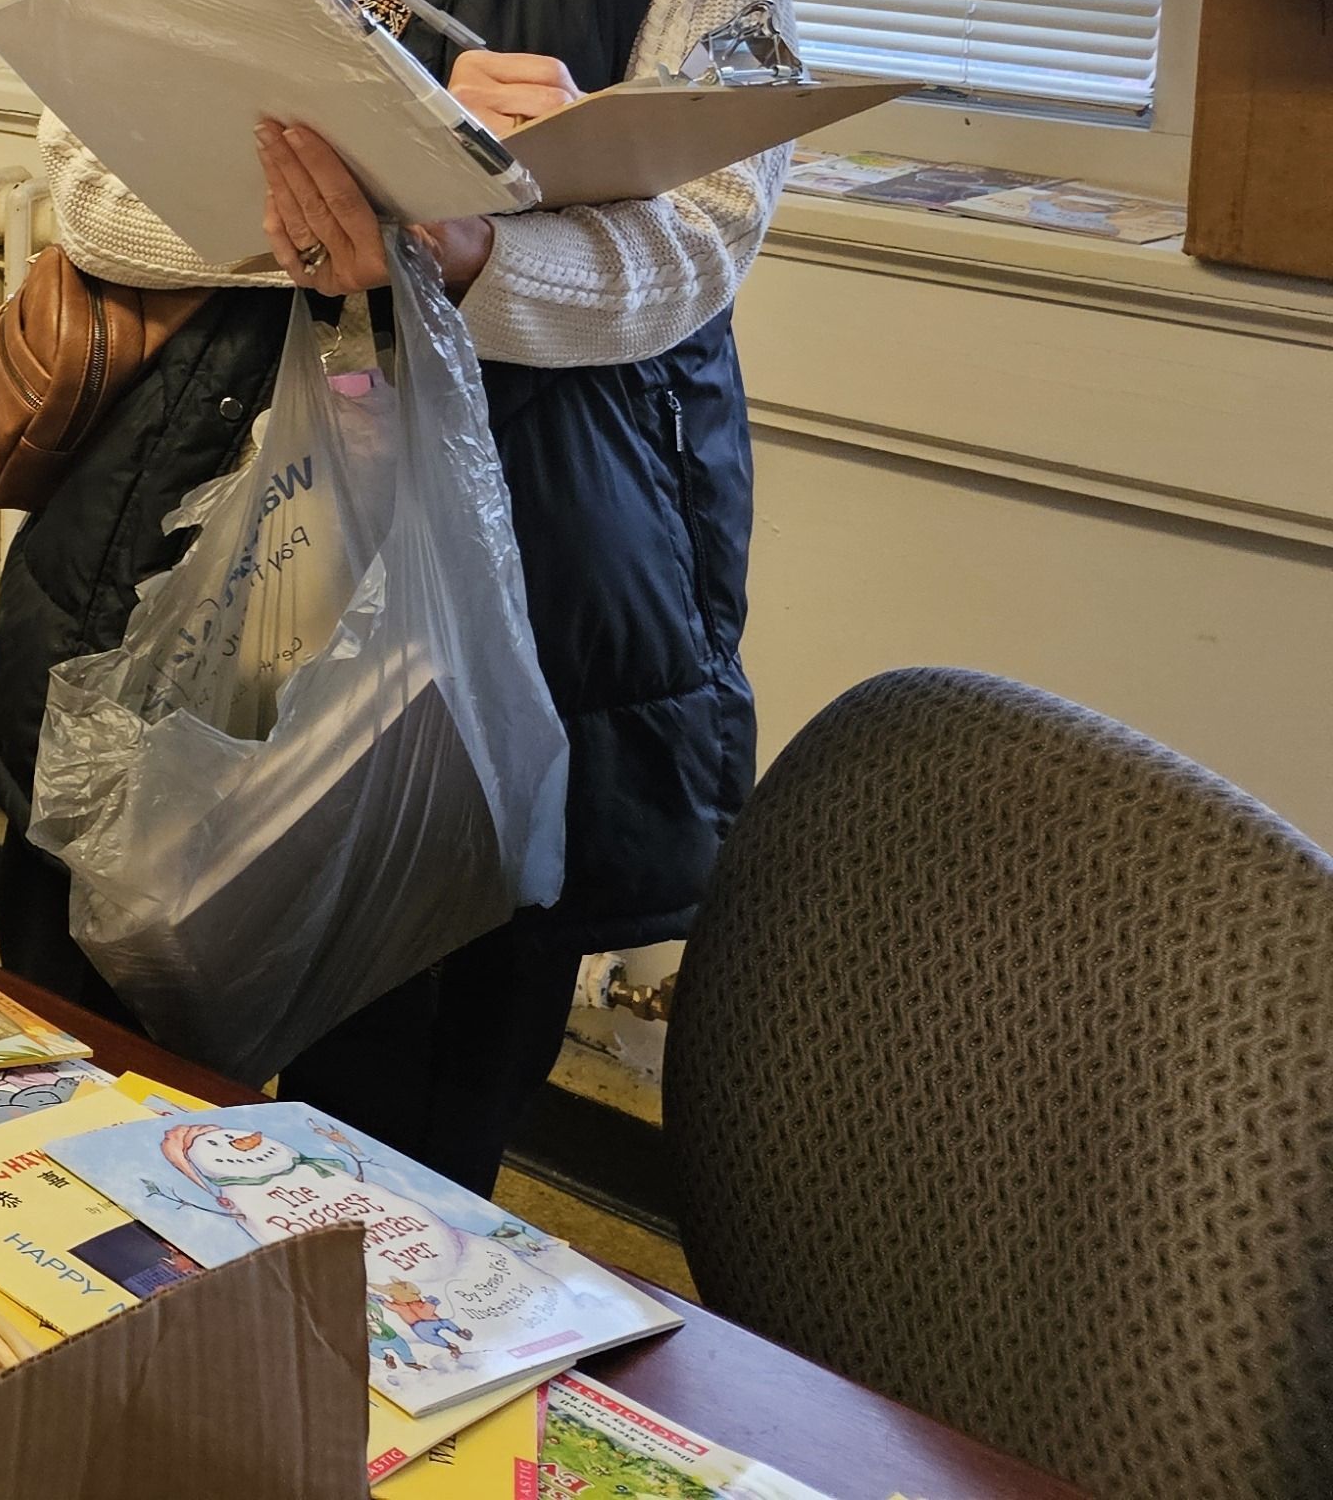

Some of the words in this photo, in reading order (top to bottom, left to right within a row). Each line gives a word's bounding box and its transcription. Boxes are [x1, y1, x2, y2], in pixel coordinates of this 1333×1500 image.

[266, 1184, 320, 1210] The
[266, 1193, 386, 1236] Biggest
[363, 1212, 430, 1250] wman
[4, 1232, 106, 1296] HAPPY
[378, 1240, 439, 1272] Ever
[455, 1285, 482, 1304] By
[367, 1448, 404, 1480] ASTIC
